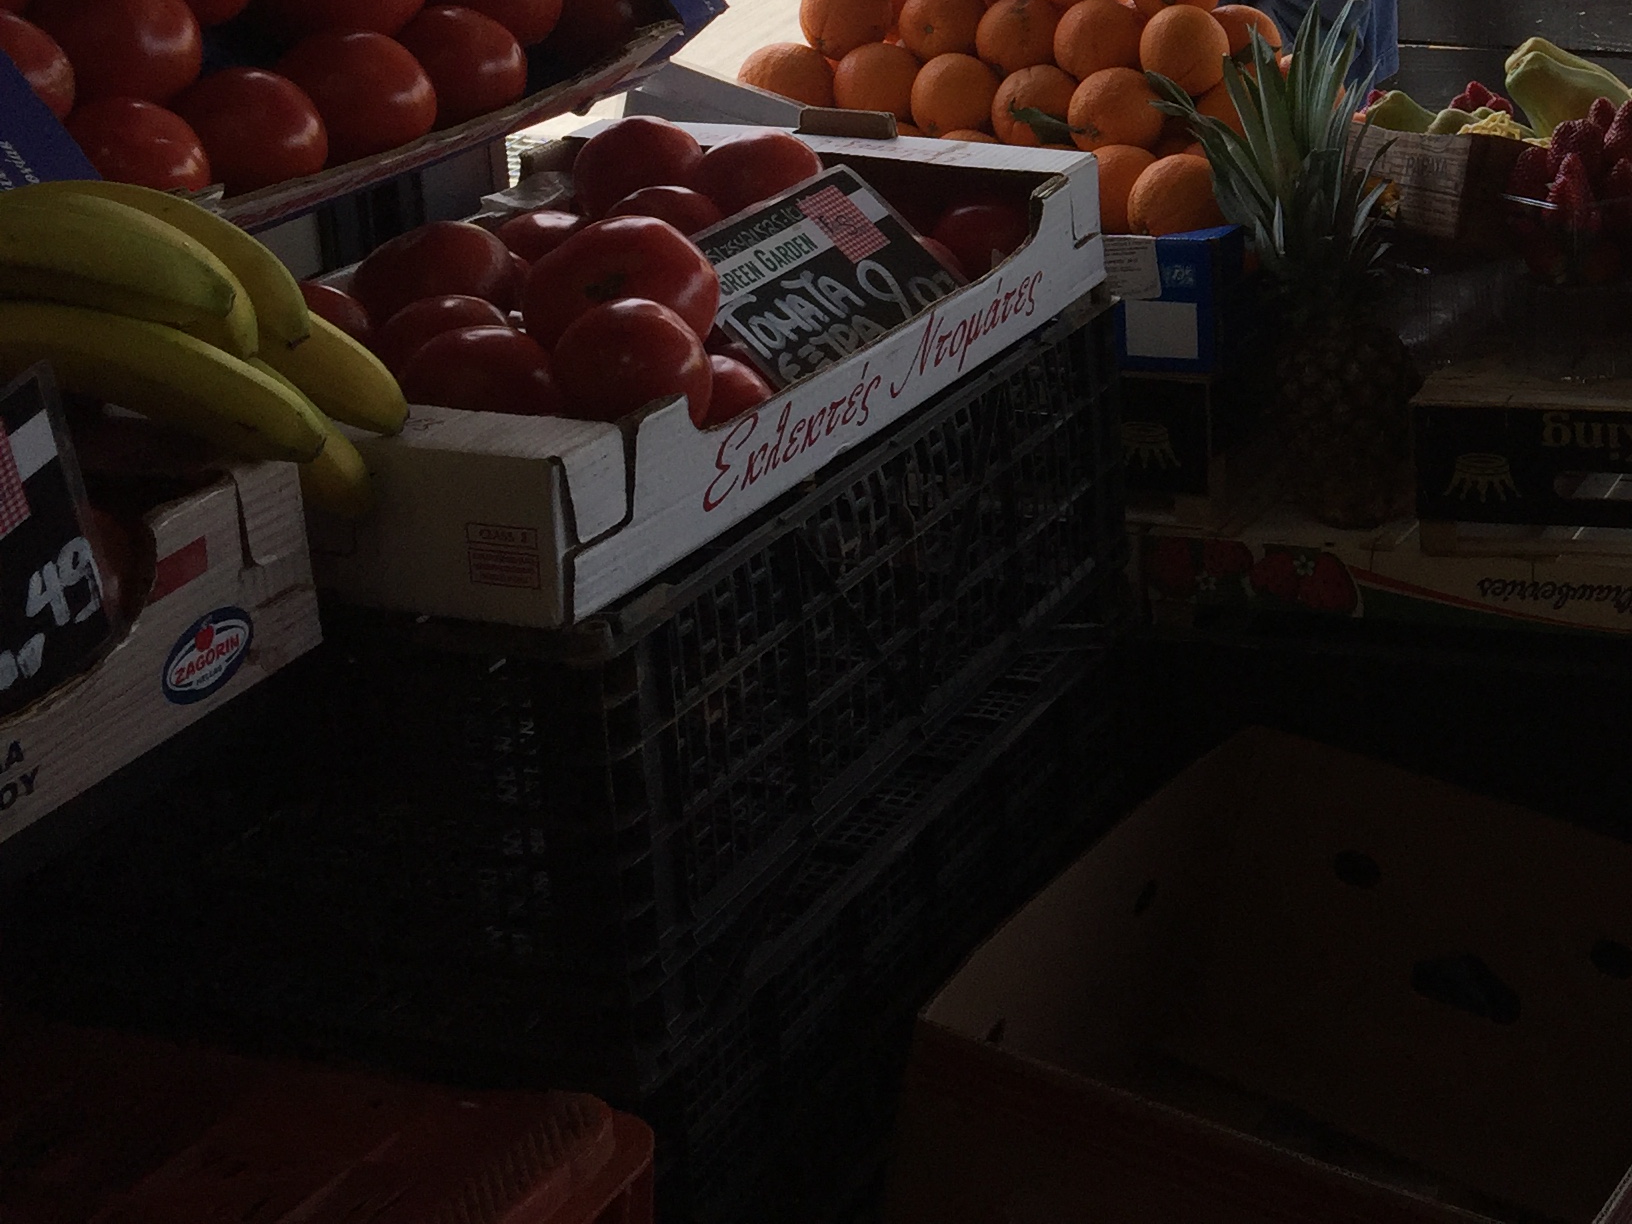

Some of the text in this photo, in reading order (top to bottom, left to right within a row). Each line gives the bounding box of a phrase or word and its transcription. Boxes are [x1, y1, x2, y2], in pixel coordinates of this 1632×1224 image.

[753, 231, 819, 272] GARDEN
[702, 270, 1043, 513] Εκλεκτές Ντομάτες
[174, 633, 240, 686] ZAGORIN
